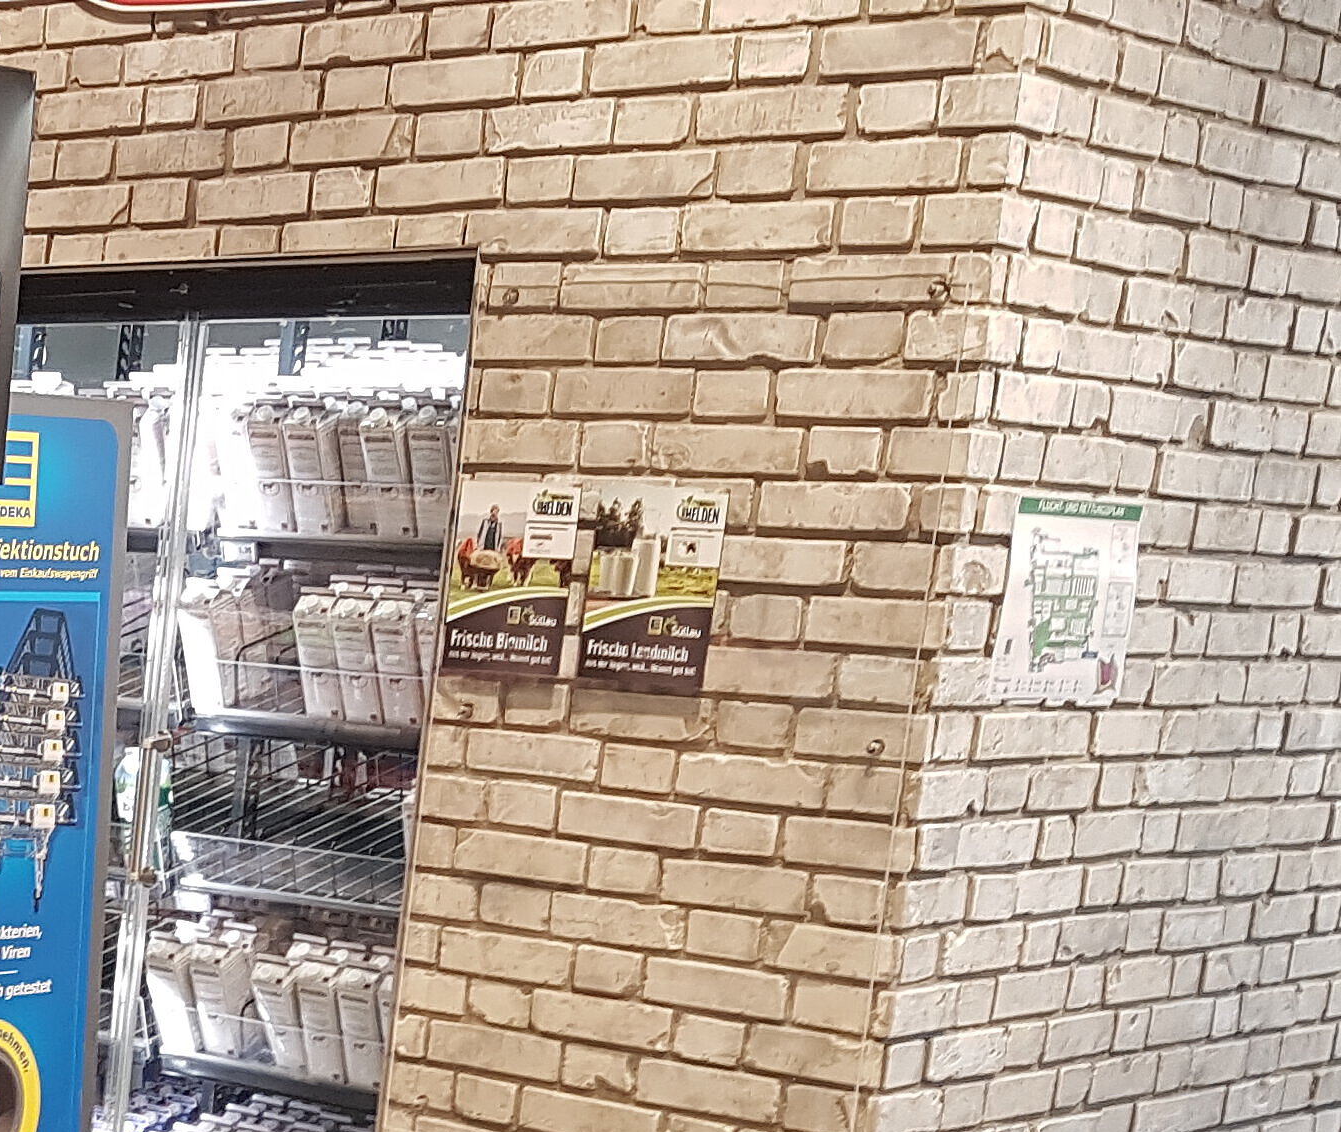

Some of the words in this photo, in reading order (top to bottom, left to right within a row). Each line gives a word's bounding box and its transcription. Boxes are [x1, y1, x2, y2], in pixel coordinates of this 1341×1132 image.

[0, 569, 18, 578] vom
[450, 629, 494, 648] Frische
[587, 639, 629, 657] Frische
[1, 945, 31, 960] Viren
[4, 979, 52, 1000] getestet
